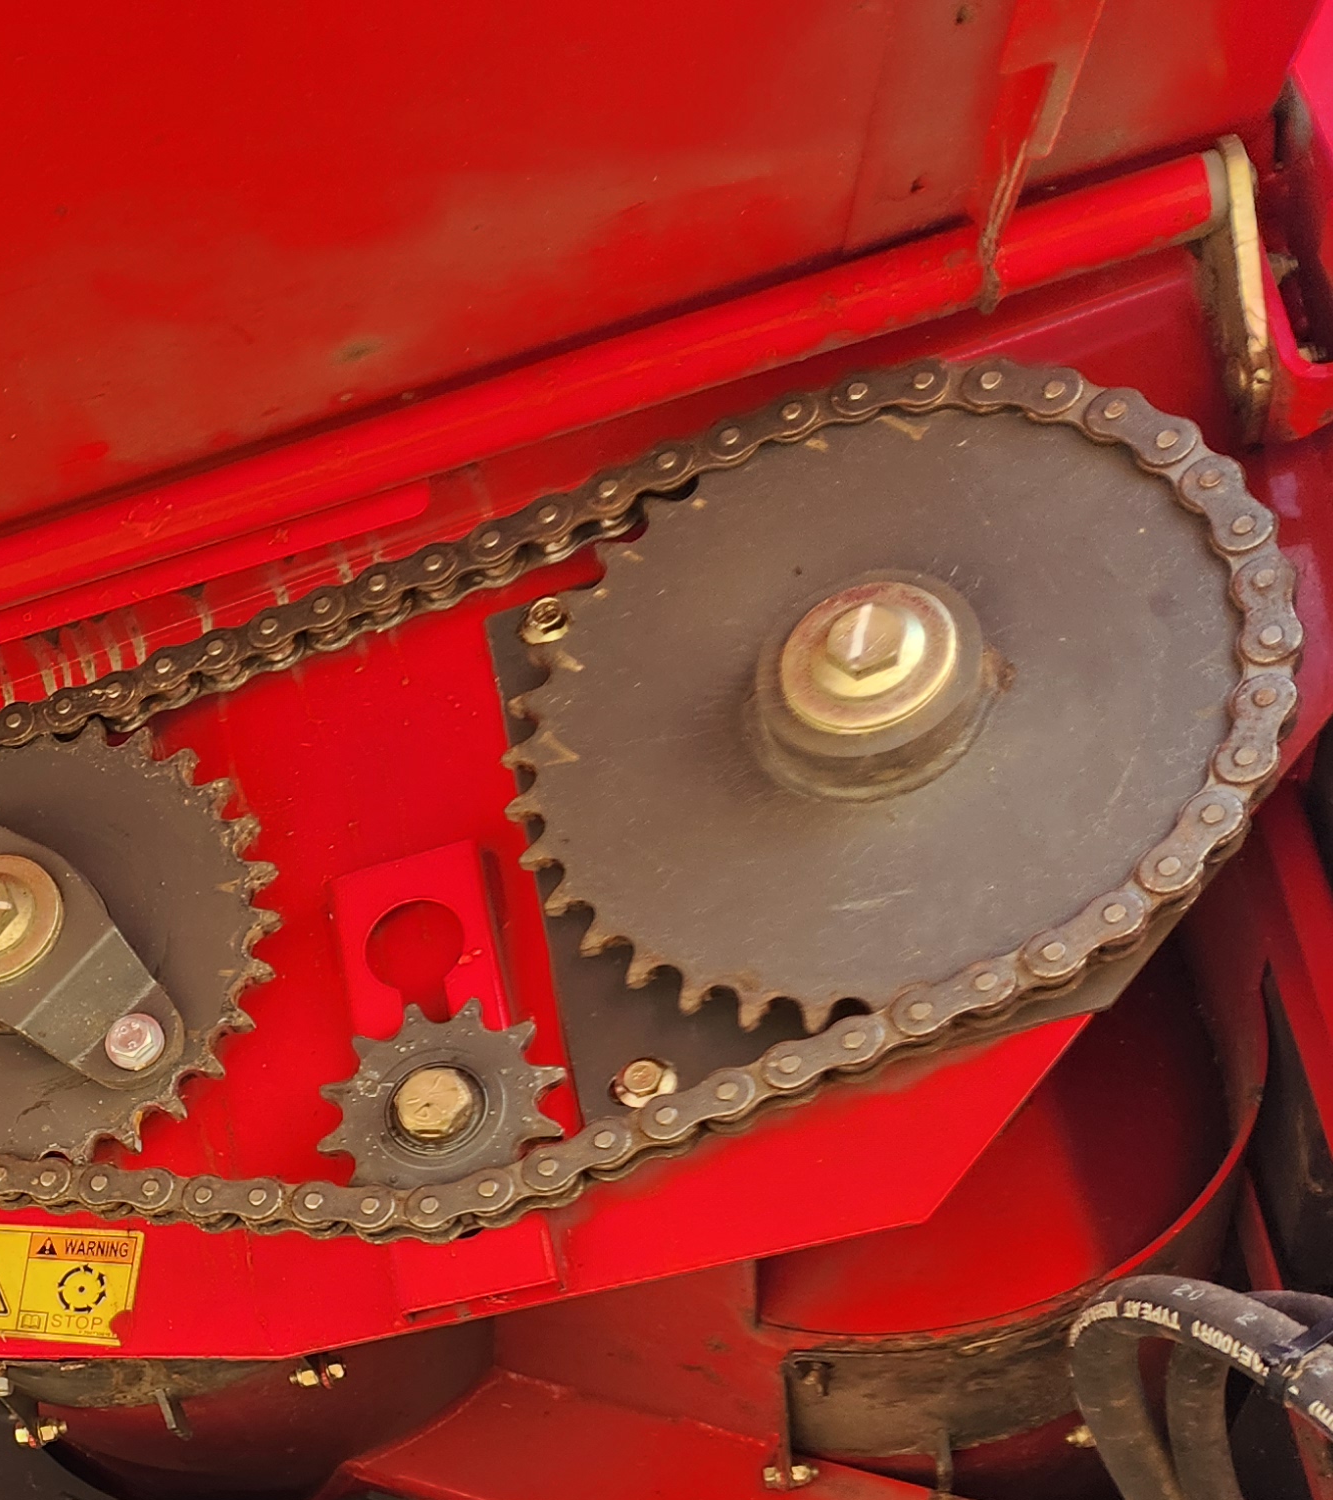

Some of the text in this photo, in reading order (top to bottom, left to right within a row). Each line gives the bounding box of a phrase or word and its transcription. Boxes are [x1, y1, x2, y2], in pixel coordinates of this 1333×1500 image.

[64, 1239, 129, 1258] WARNING
[51, 1313, 103, 1331] STOP
[1140, 1302, 1182, 1331] TYPE
